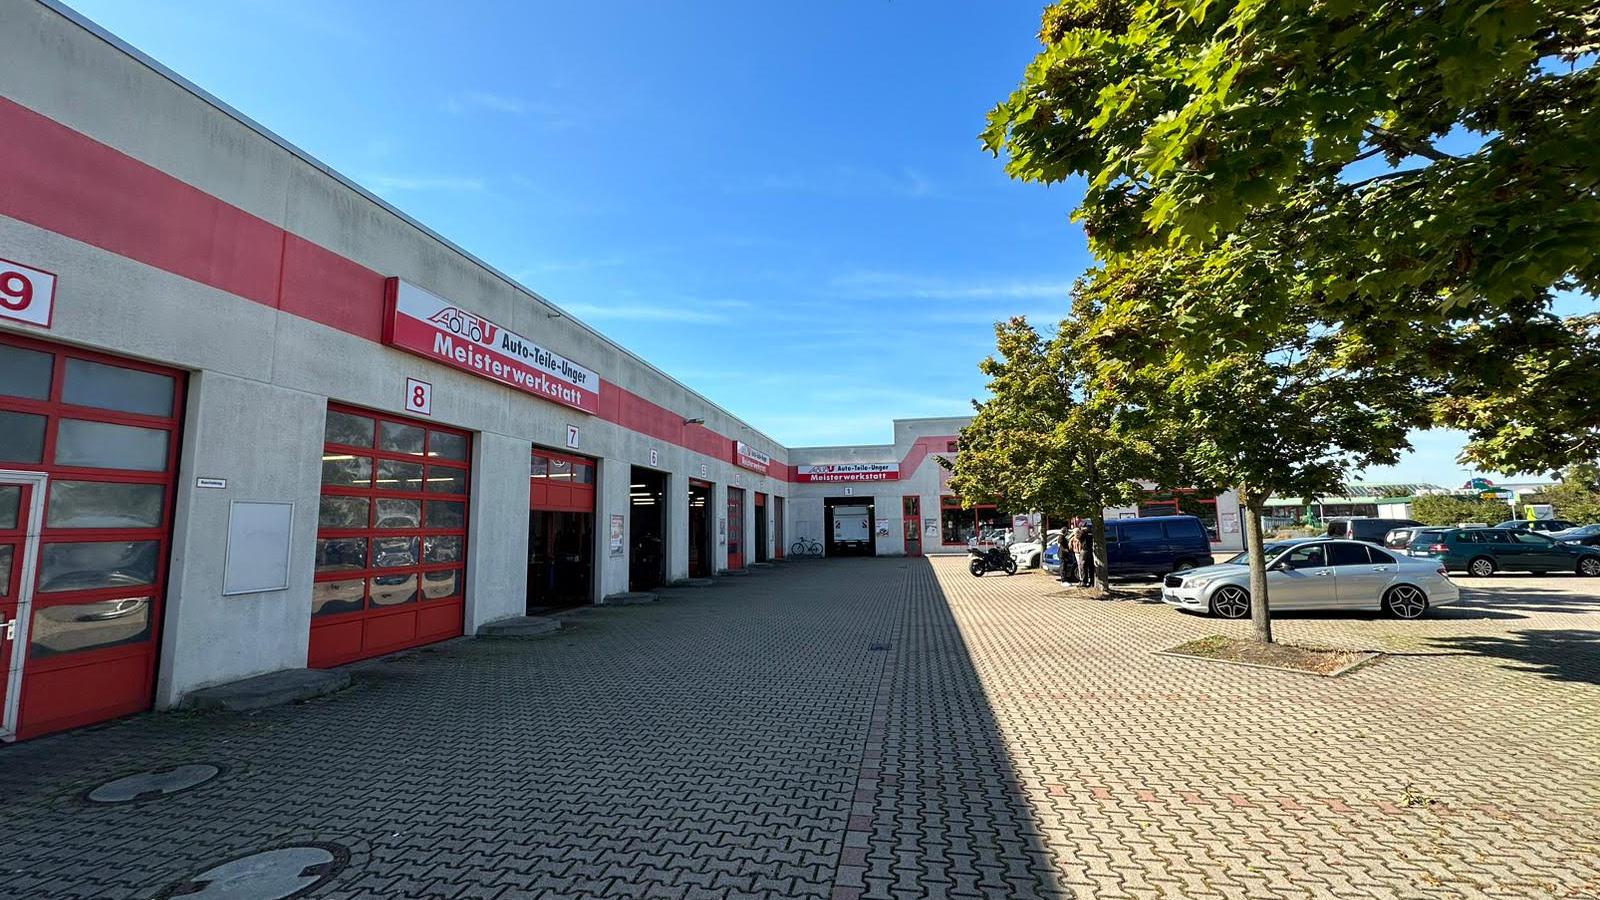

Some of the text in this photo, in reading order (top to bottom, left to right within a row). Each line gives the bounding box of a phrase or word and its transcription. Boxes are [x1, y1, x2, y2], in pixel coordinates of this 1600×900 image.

[0, 271, 33, 311] 9
[501, 332, 587, 384] Auto-Teile-Unger
[433, 332, 582, 405] Meisterwerkstatt
[413, 385, 425, 408] 8
[570, 428, 577, 444] 7
[650, 451, 656, 464] 6
[810, 473, 886, 481] Meisterwerkstatt
[837, 464, 889, 472] Auto-Teile-Unger
